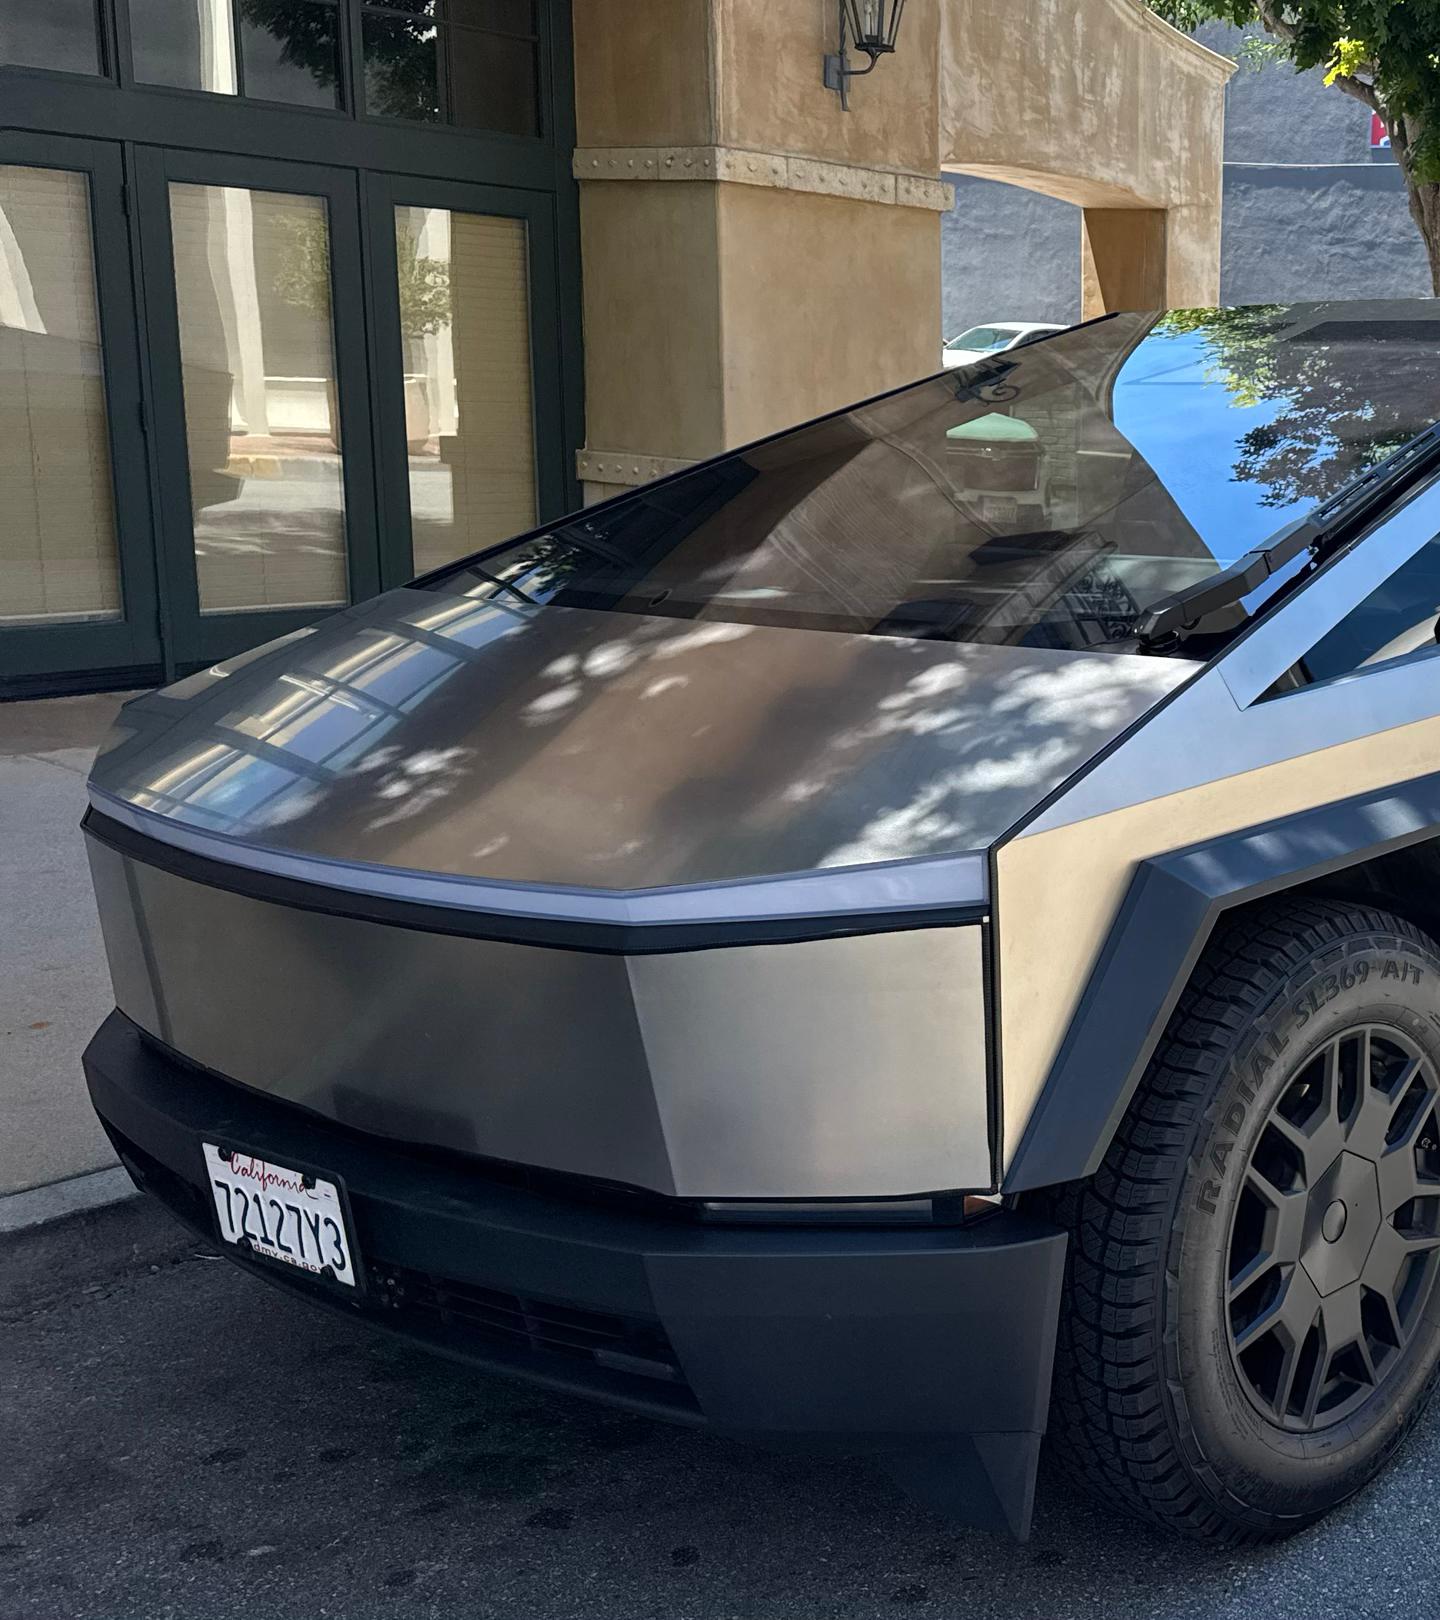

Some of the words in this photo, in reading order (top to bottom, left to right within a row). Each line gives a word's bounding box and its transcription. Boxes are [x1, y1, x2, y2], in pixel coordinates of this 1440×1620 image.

[1196, 1031, 1290, 1217] RADIAL
[1292, 961, 1370, 1030] SL369
[1382, 959, 1424, 985] A/T
[214, 1179, 346, 1271] 72127Y3
